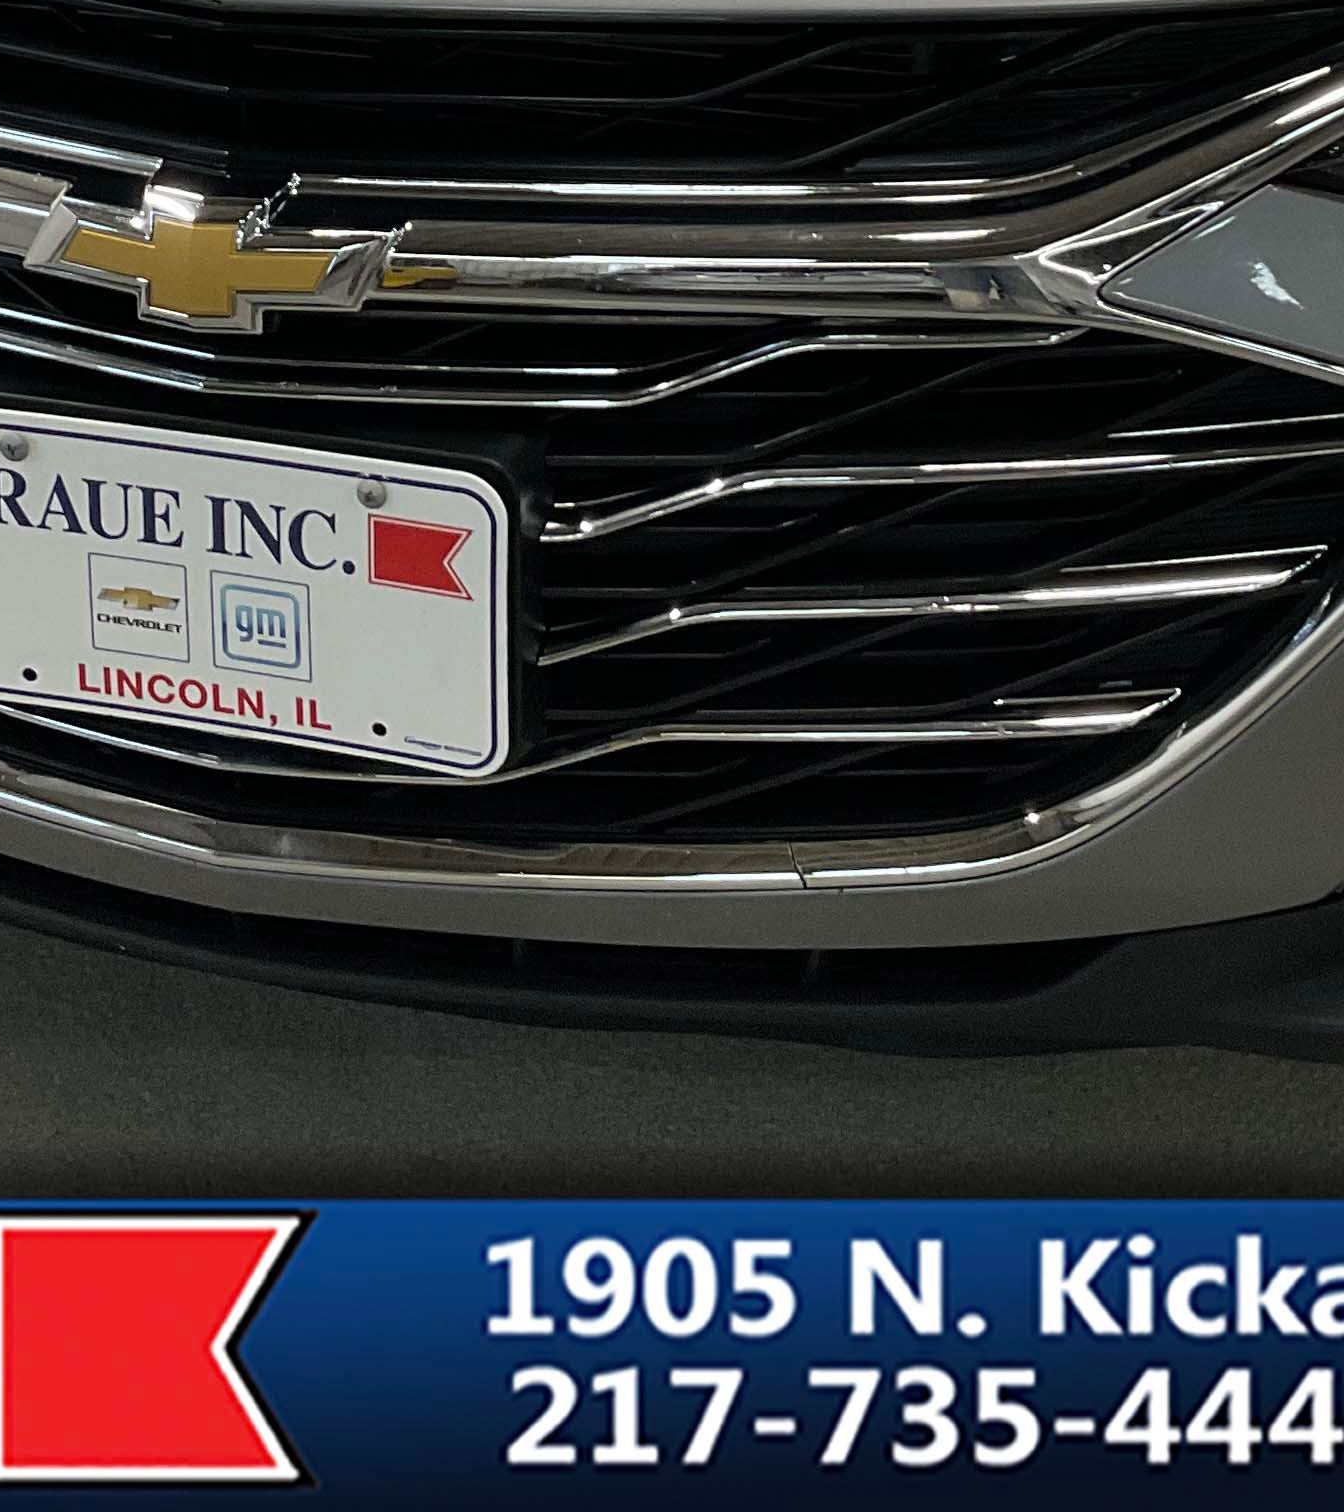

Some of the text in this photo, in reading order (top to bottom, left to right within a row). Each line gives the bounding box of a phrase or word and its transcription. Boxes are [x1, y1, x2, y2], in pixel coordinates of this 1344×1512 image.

[204, 495, 356, 576] INC.
[96, 612, 183, 634] CHEVROLET
[235, 604, 287, 643] gm
[77, 662, 332, 731] LINCOLN, IL
